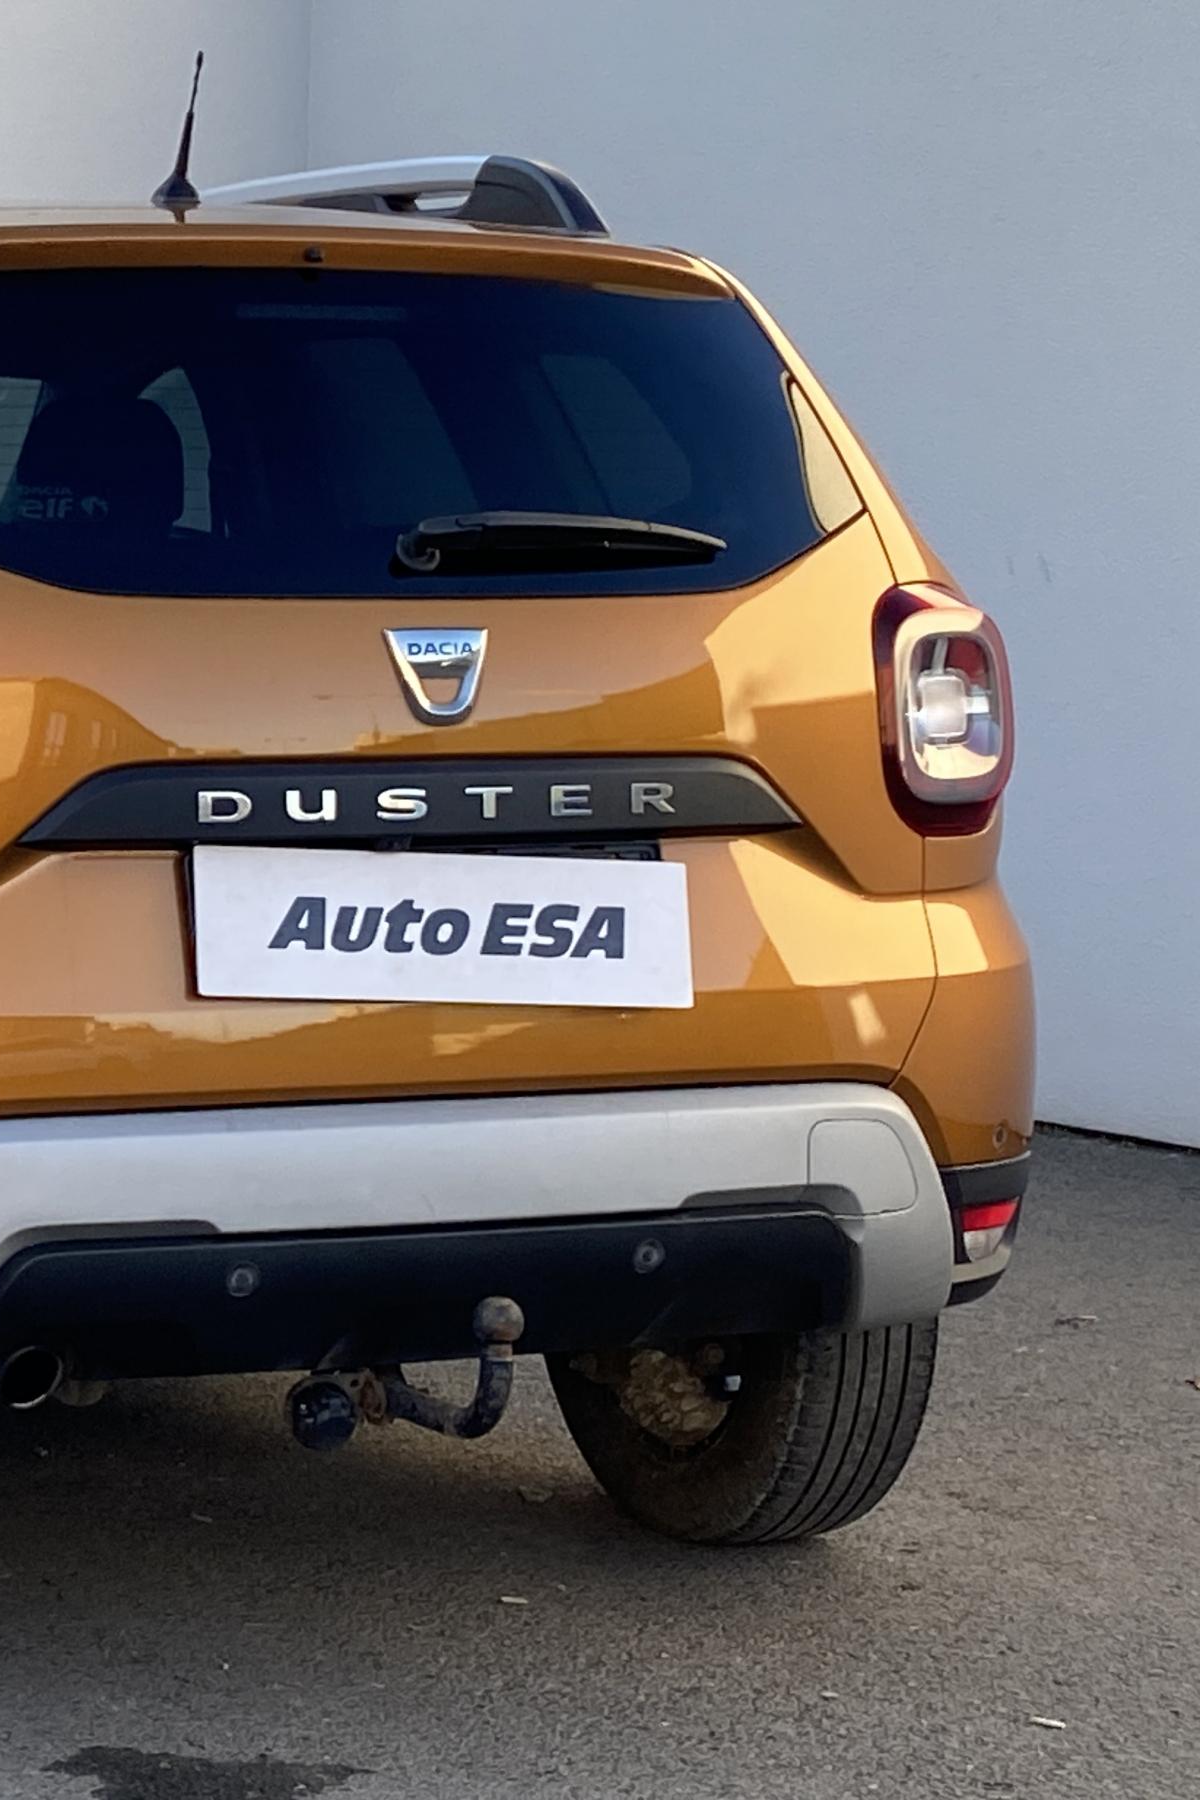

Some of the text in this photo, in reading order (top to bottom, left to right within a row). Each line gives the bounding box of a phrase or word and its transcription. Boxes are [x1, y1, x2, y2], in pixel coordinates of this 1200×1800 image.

[20, 497, 74, 519] elf
[406, 642, 473, 656] DACIA
[197, 782, 676, 824] DUSTER
[267, 896, 626, 959] Auto ESA
